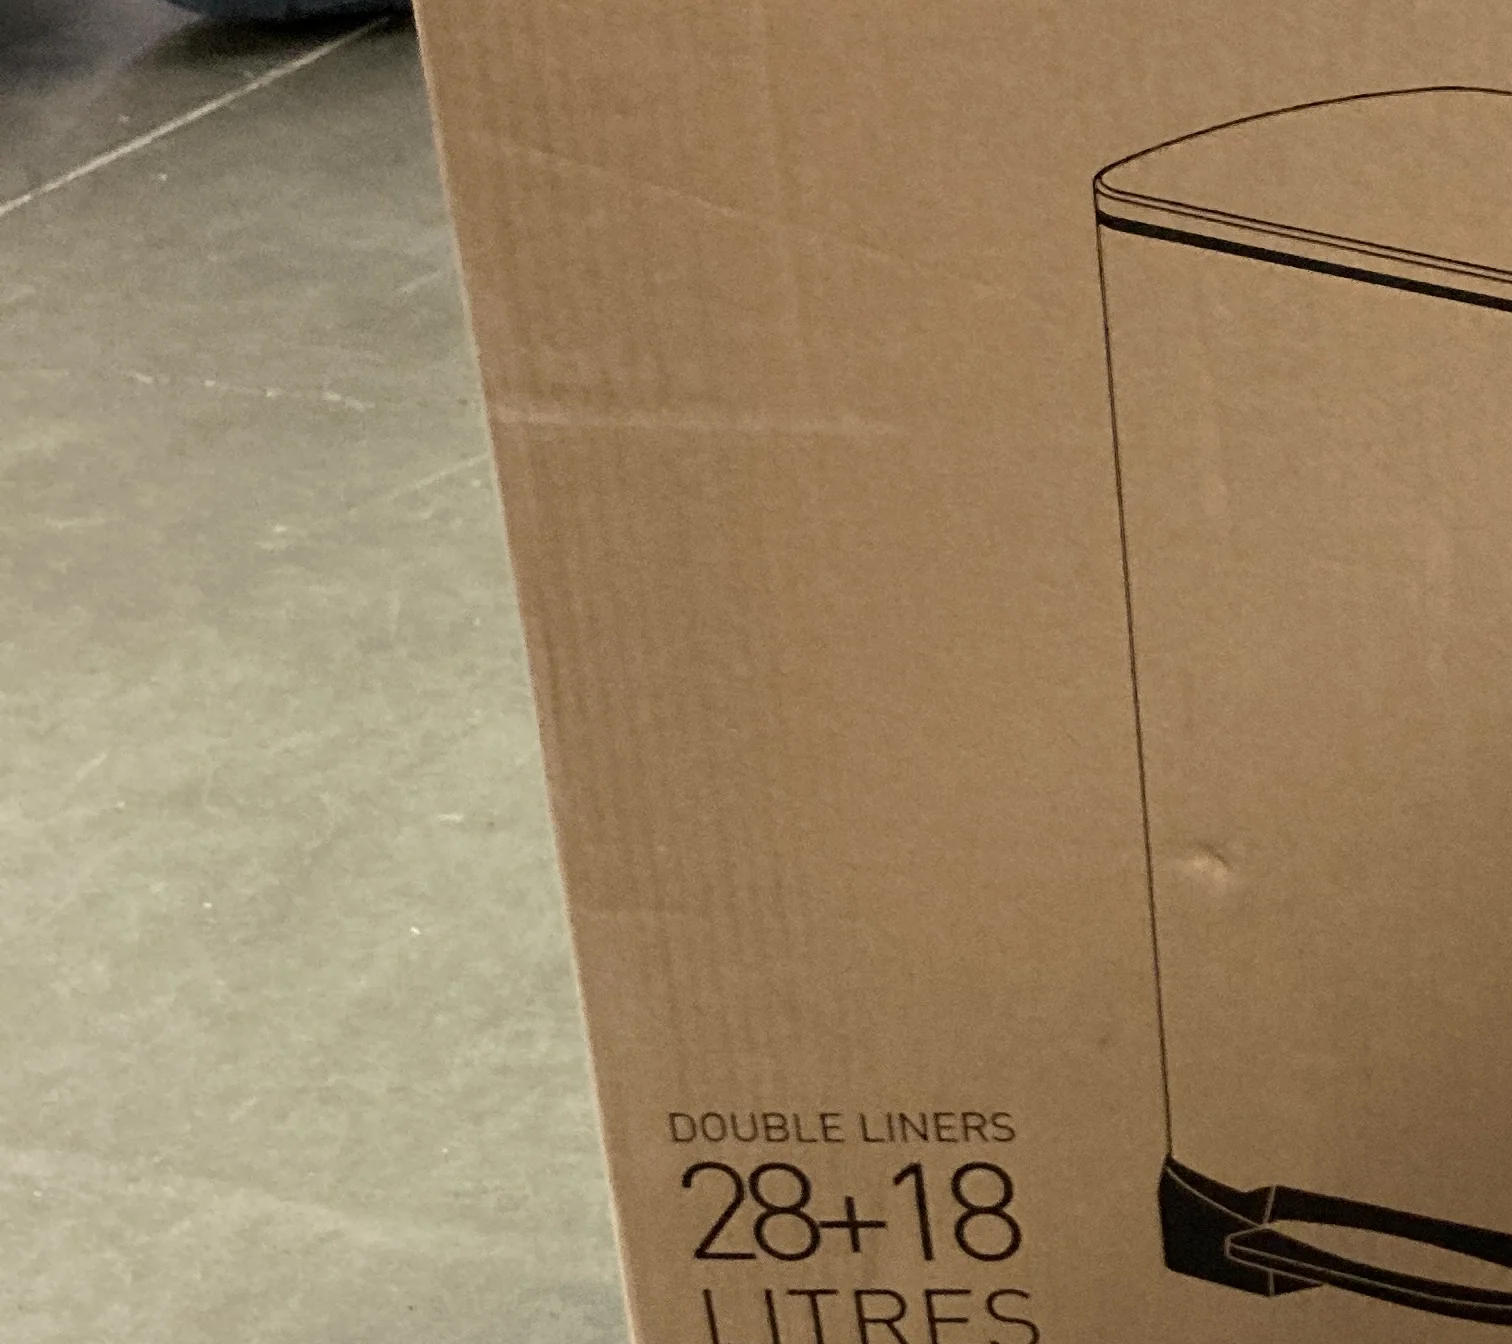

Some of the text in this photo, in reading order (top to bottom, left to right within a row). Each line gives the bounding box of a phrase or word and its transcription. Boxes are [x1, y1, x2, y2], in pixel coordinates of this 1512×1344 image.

[668, 1111, 1017, 1144] DOUBLE LINERS
[681, 1160, 1023, 1262] 28+18
